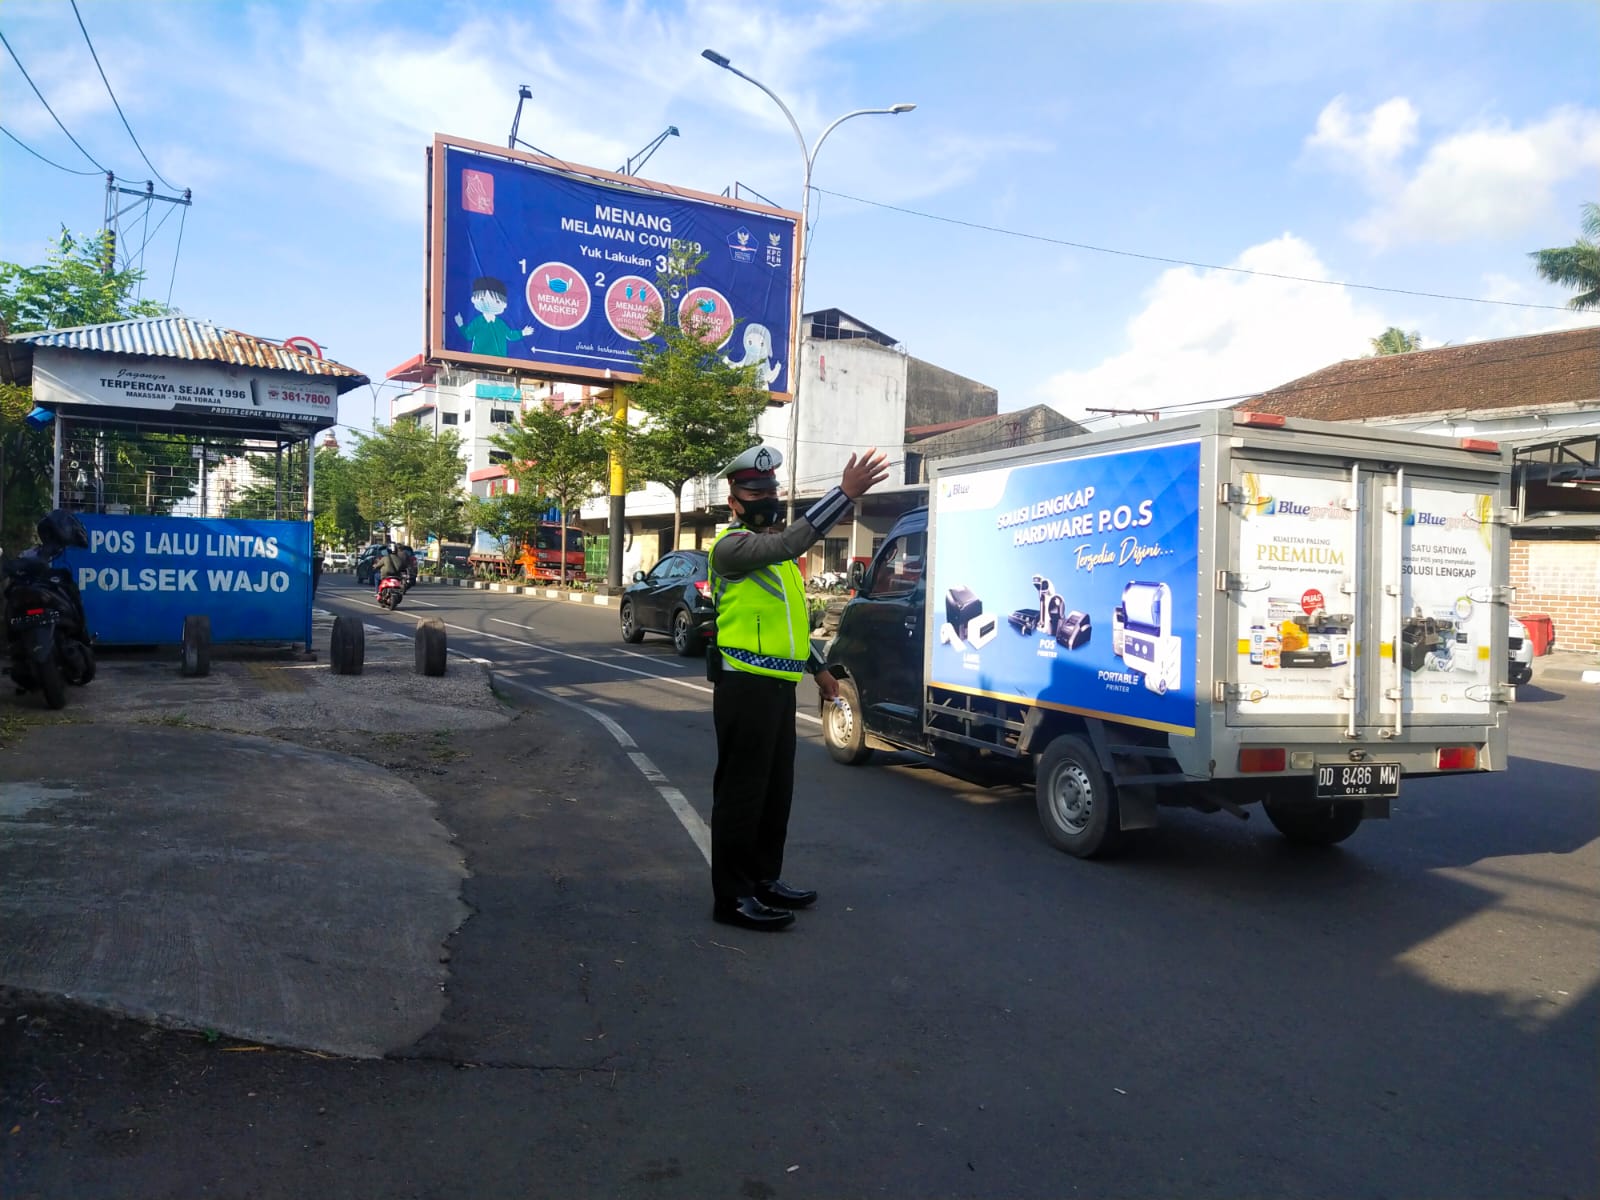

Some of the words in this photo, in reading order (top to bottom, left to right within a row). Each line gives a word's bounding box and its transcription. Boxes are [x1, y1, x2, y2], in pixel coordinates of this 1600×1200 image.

[595, 204, 672, 233] MENANG
[561, 217, 635, 243] MELAWAN
[638, 232, 702, 254] COVID-19
[518, 258, 527, 274] 1
[579, 245, 602, 259] Yuk
[604, 249, 652, 268] Lakukan
[655, 255, 685, 275] 3M
[594, 272, 606, 288] 2
[670, 284, 680, 299] 3
[537, 293, 580, 307] MEMAKAI
[538, 303, 578, 317] MASKER
[117, 368, 166, 381] Jagonya
[99, 378, 175, 393] TERPERCAYA
[179, 384, 214, 396] SEJAK
[219, 388, 246, 399] 1996
[126, 390, 166, 400] MAKASSAR
[174, 394, 192, 402] TANA
[194, 396, 221, 405] TORAJA
[281, 390, 331, 405] 361-7800
[211, 407, 239, 415] PROSES
[265, 411, 290, 419] MUDAH
[997, 505, 1029, 529] SOLUSI
[1031, 486, 1095, 521] LENGKAP
[1014, 513, 1093, 547] HARDWARE
[1098, 499, 1153, 532] P.O.S
[91, 530, 135, 554] POS
[145, 531, 199, 555] LALU
[206, 534, 279, 559] LINTAS
[1273, 536, 1305, 544] KUALITAS
[1306, 537, 1331, 546] PALING
[1073, 543, 1116, 571] Tersedia
[1256, 543, 1345, 566] PREMIUM
[1411, 544, 1431, 553] SATU
[1433, 545, 1467, 556] SATUNYA
[1402, 564, 1434, 576] SOLUSI
[1436, 566, 1477, 578] LENGKAP
[78, 567, 199, 592] POLSEK
[207, 569, 289, 593] WAJO
[1039, 639, 1055, 650] POS
[1097, 670, 1139, 685] PORTABLE
[1105, 684, 1130, 693] PRINTER
[1318, 767, 1334, 786] DD
[1342, 767, 1372, 786] 8486
[1379, 766, 1397, 785] MW
